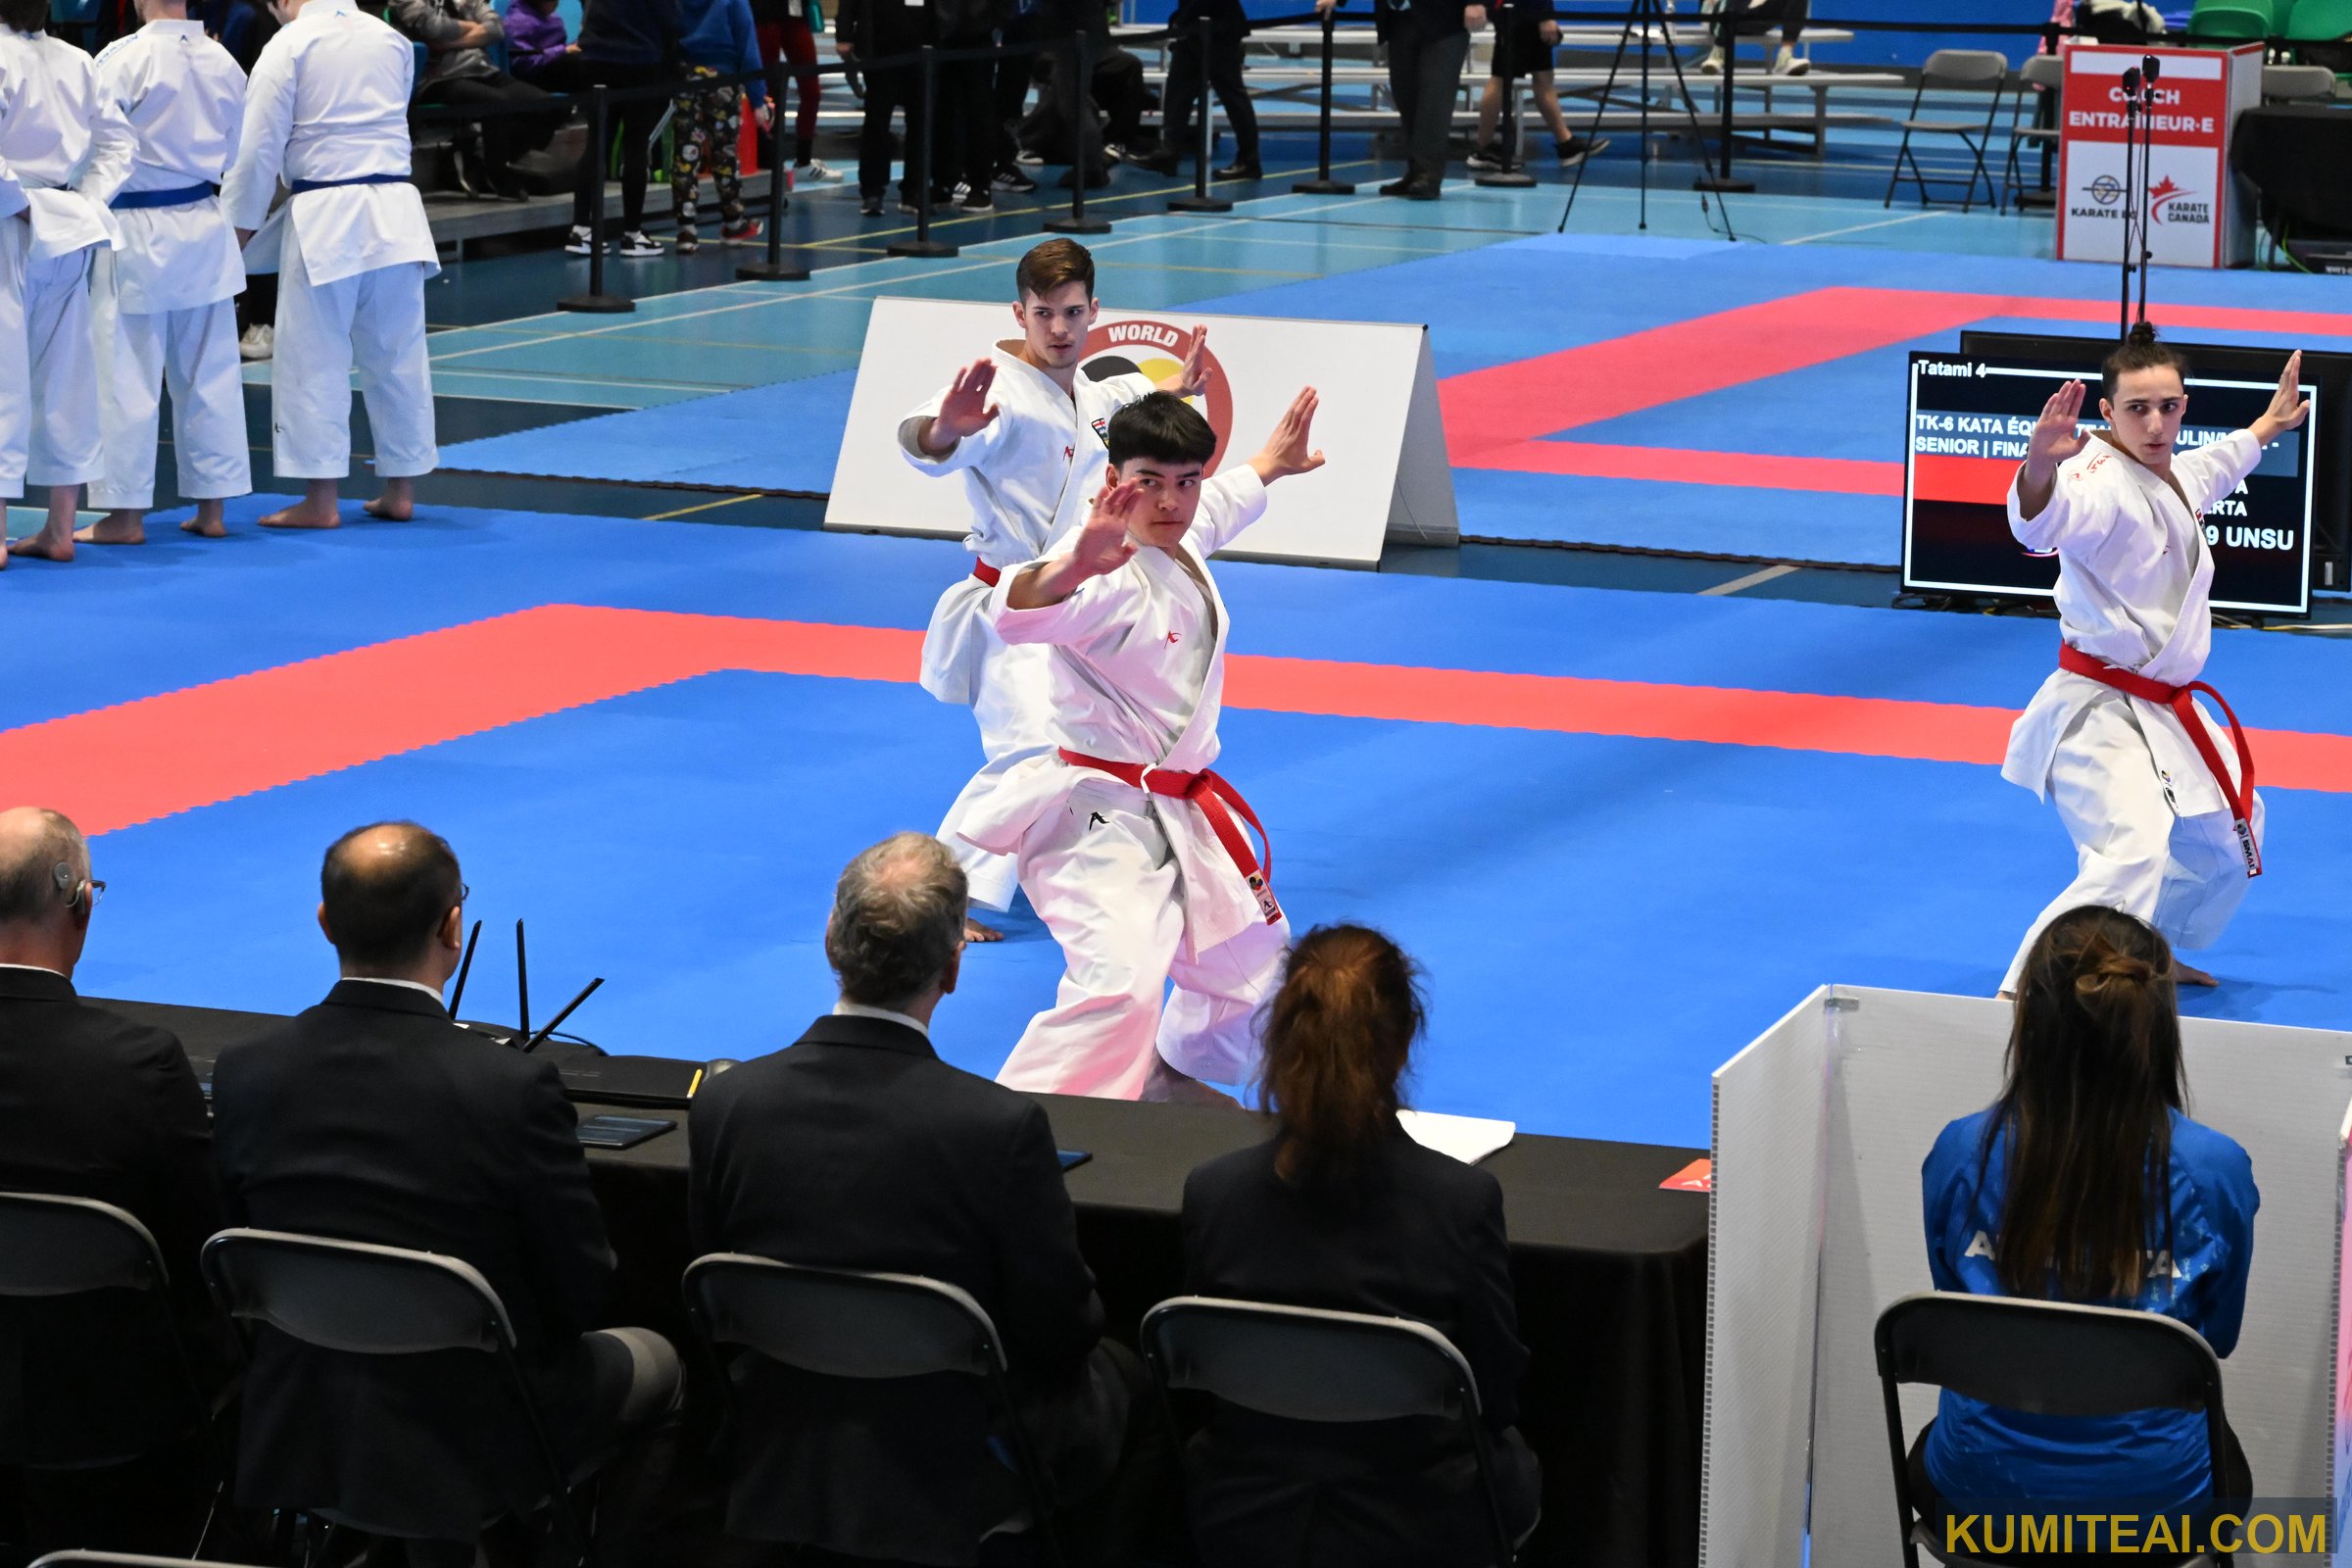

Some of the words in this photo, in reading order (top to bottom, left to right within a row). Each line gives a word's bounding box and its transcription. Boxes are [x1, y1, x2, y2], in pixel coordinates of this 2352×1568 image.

[2071, 208, 2119, 219] KARATE
[2168, 202, 2209, 213] KARATE
[2168, 213, 2210, 223] CANADA
[1107, 324, 1179, 347] WORLD
[1918, 360, 1973, 377] Tatami
[1976, 364, 1986, 378] 4
[1916, 415, 1954, 432] TK-6
[1957, 417, 2004, 434] KATA
[1915, 436, 1980, 454] SENIOR
[1992, 441, 2029, 458] FINA
[2226, 526, 2294, 551] UNSU
